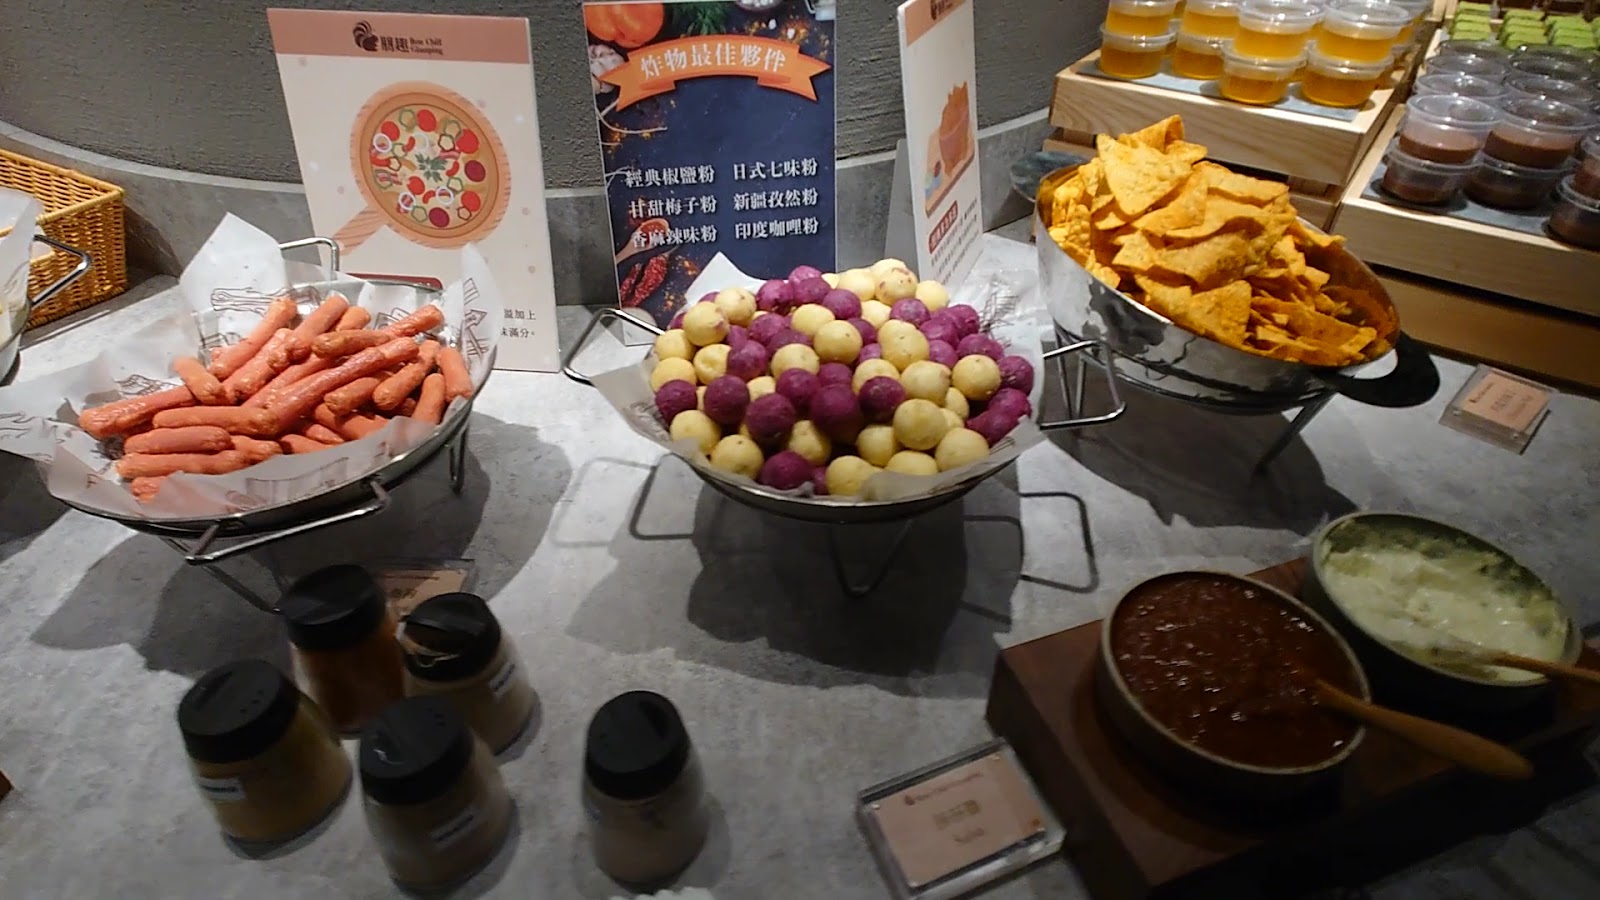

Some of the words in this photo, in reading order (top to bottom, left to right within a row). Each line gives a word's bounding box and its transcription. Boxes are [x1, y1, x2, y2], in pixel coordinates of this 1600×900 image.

[640, 42, 786, 80] 炸物最佳夥伴
[625, 164, 715, 188] 經典椒鹽粉
[733, 157, 818, 180] 日式七味粉
[628, 195, 717, 218] 甘甜梅子粉
[733, 187, 818, 211] 新疆孜然粉
[632, 225, 717, 248] 香麻辣味粉
[734, 217, 819, 240] 印度咖哩粉
